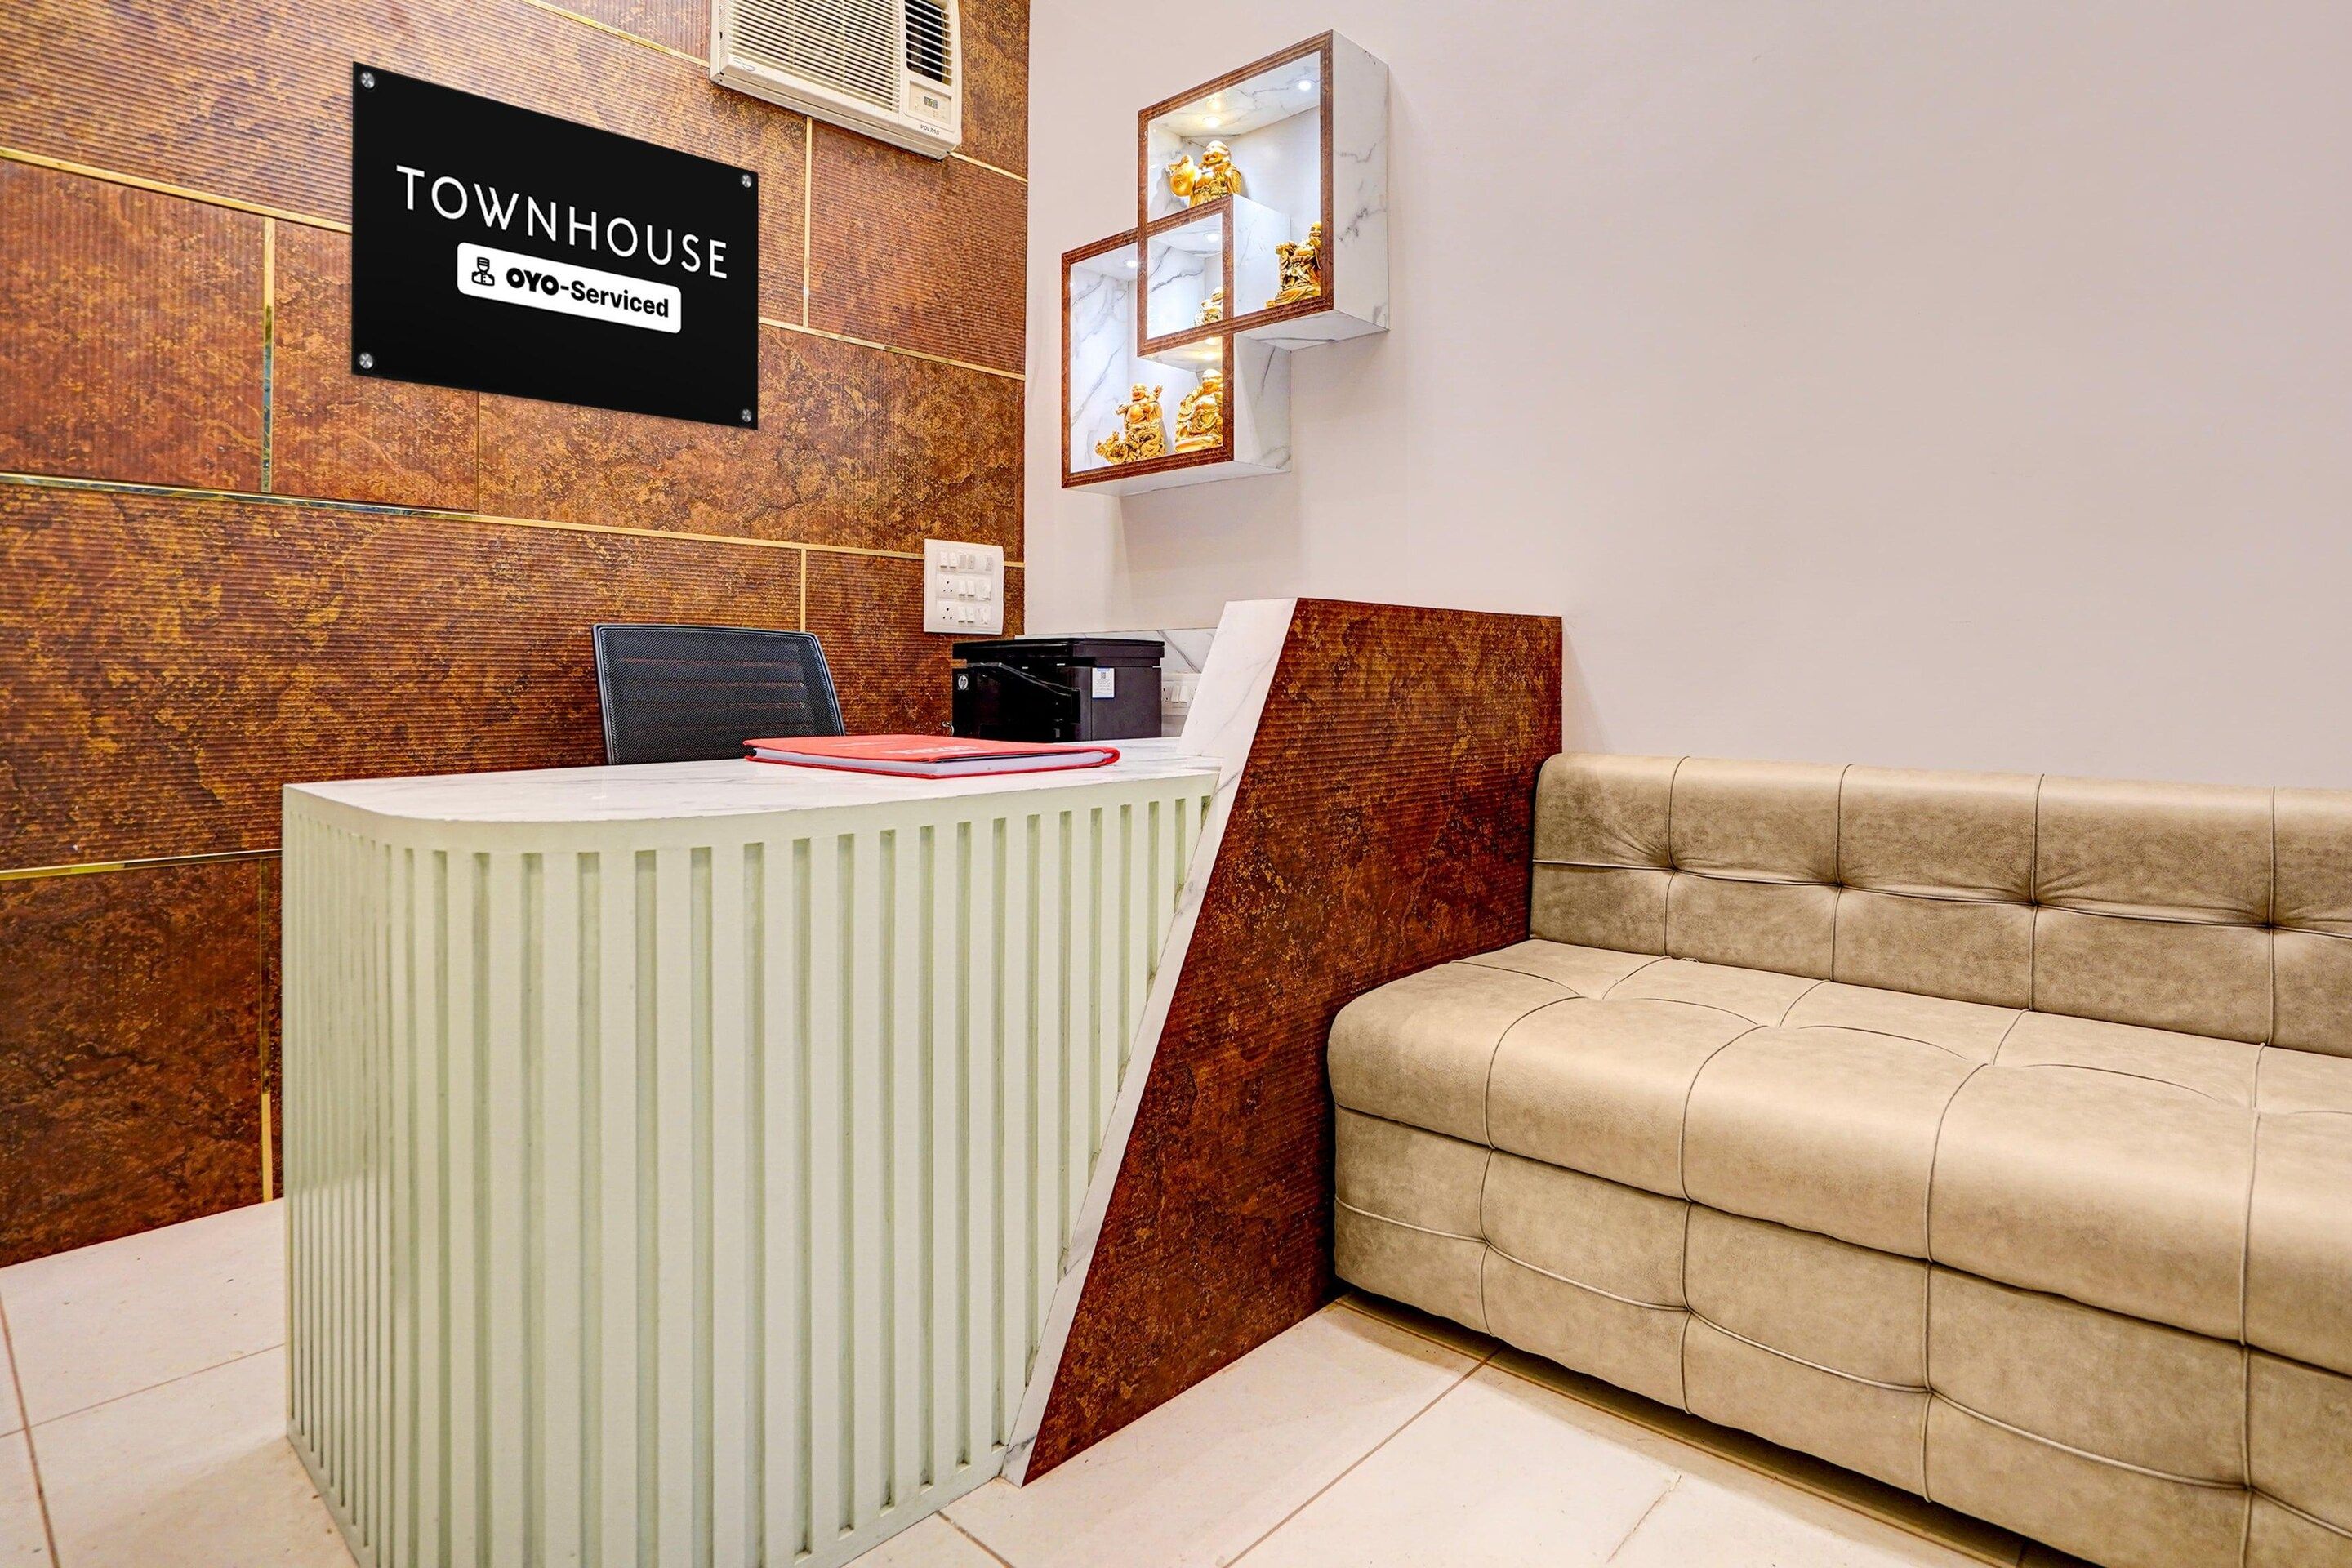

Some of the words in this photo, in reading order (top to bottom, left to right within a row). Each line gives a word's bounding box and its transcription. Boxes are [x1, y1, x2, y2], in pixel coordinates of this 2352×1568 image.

[920, 124, 940, 136] VOLTAS
[396, 164, 728, 279] TOWNHOUSE
[506, 267, 669, 318] OYO-Serviced
